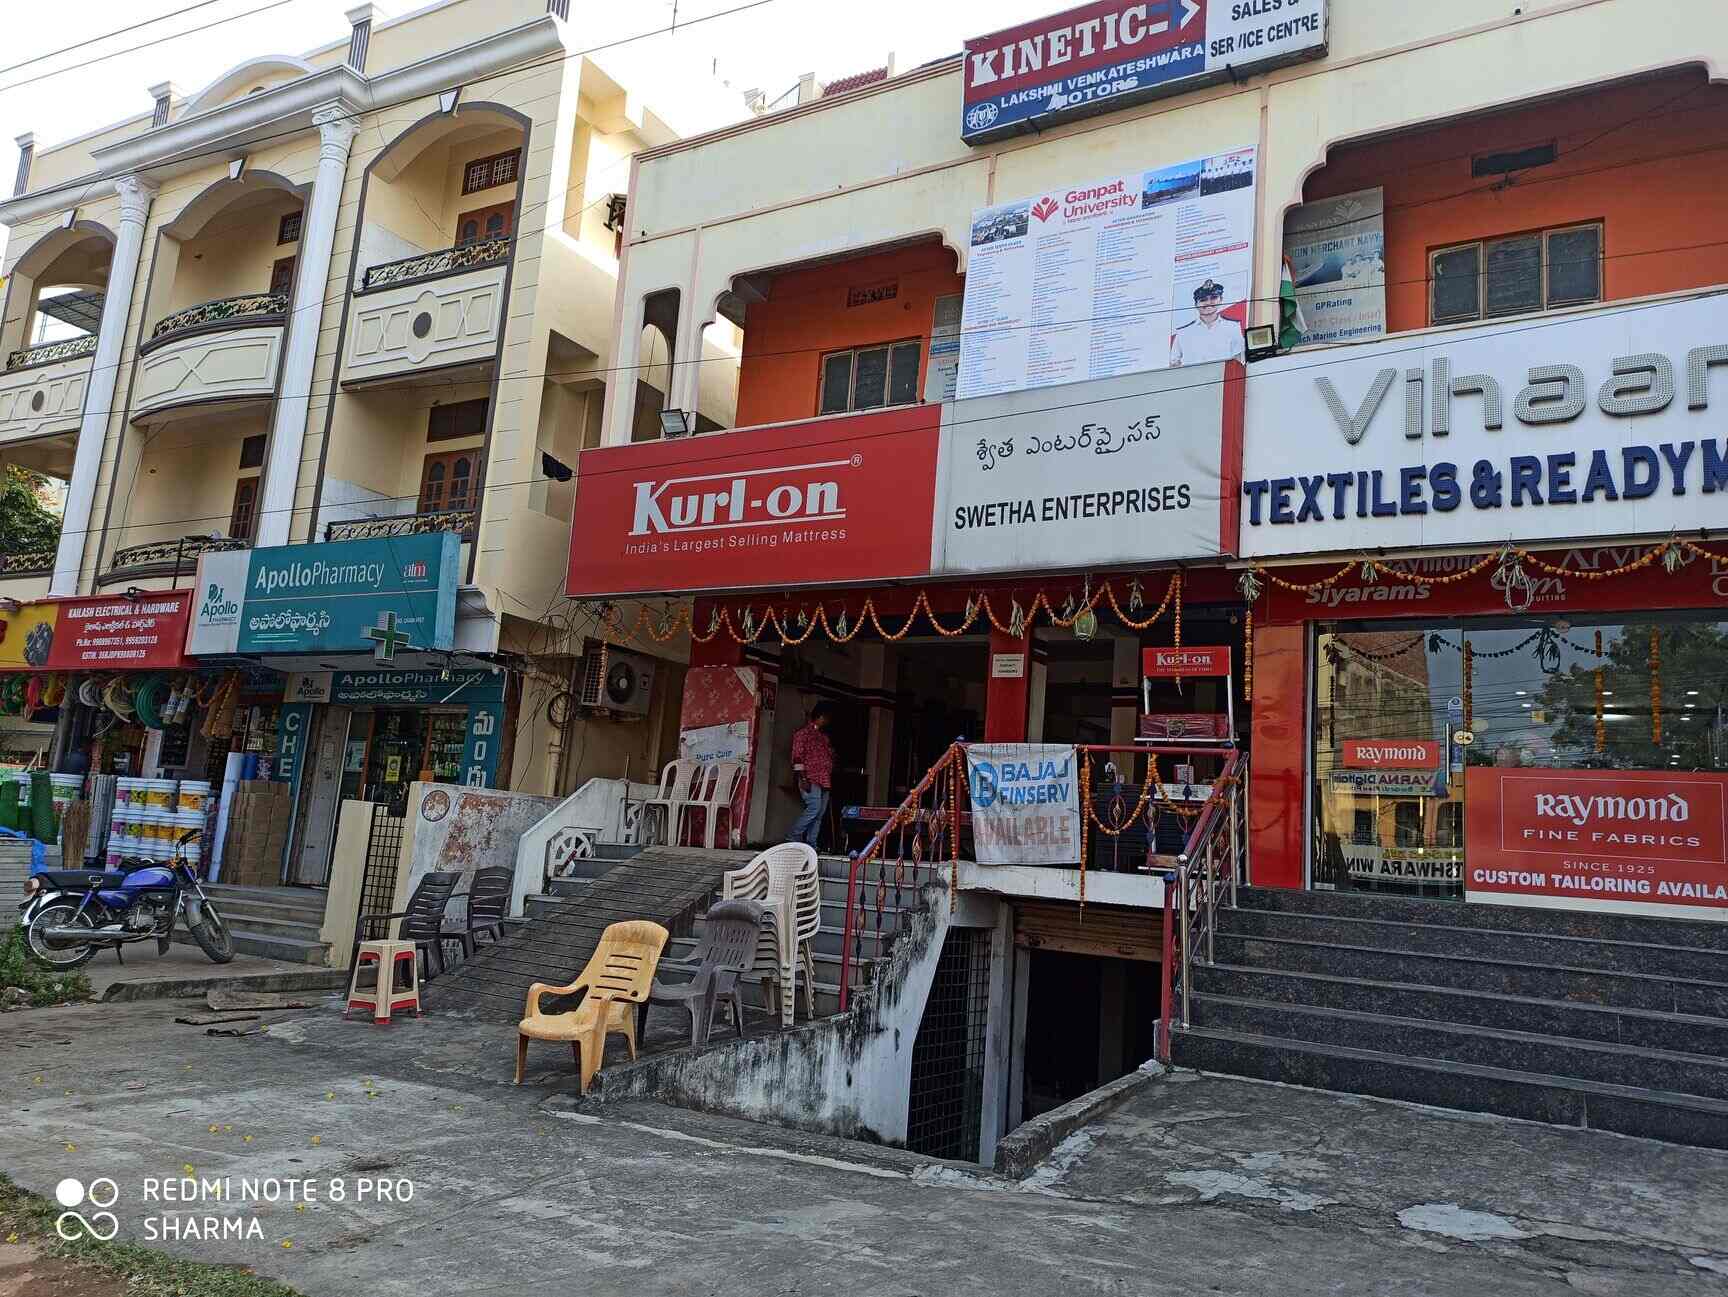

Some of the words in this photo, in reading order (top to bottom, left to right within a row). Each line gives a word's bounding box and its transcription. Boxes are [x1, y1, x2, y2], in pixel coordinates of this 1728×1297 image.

[1231, 0, 1282, 21] SALES
[1267, 13, 1319, 43] CENTRE
[970, 4, 1149, 88] KINETIC
[1000, 82, 1063, 109] LAKSHMI
[1067, 44, 1204, 91] VENKATESHWARA
[1065, 179, 1125, 204] Ganpat
[1063, 193, 1138, 218] University
[1339, 323, 1382, 339] Engineering
[1243, 461, 1462, 526] TEXTILES
[1469, 459, 1503, 509] &
[1510, 438, 1728, 507] READYM
[628, 464, 847, 537] Kurl-on
[954, 499, 1036, 530] SWETHA
[1041, 483, 1191, 522] ENTERPRISES
[625, 541, 670, 555] India's
[674, 536, 725, 553] Largest
[728, 534, 778, 548] Selling
[782, 528, 847, 544] Mattress
[1305, 578, 1431, 608] Siyarams
[95, 605, 133, 617] ELECTRICAL
[141, 602, 180, 614] HARDWARE
[200, 600, 238, 622] Apollo
[1356, 746, 1427, 764] Raymond
[1000, 758, 1071, 782] BAJAJ
[999, 783, 1070, 805] FINSERV
[1535, 792, 1691, 825] Raymond
[1522, 828, 1579, 842] FINE
[1592, 832, 1702, 848] FABRICS
[1563, 860, 1608, 872] SINCE
[1617, 863, 1657, 875] 1925
[1473, 868, 1547, 887] CUSTOM
[1551, 874, 1651, 894] TAILORING
[1656, 880, 1728, 900] AVAILA
